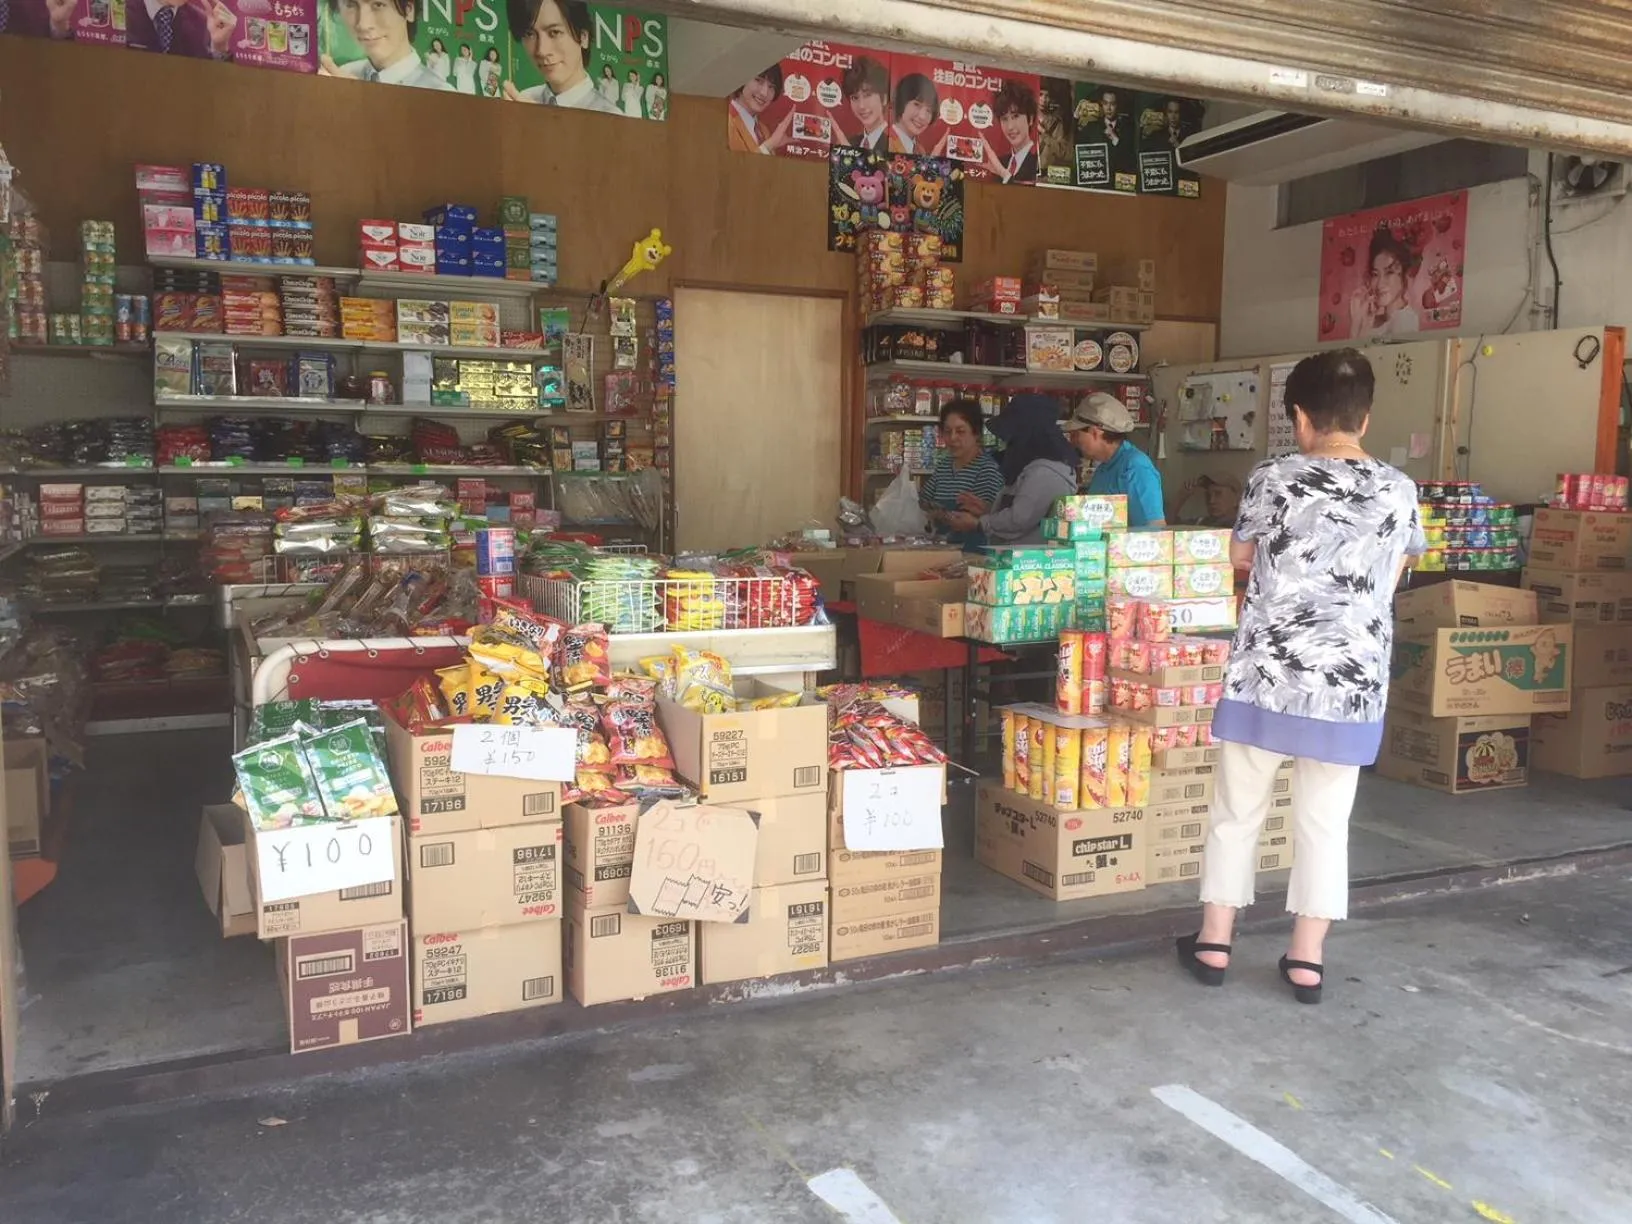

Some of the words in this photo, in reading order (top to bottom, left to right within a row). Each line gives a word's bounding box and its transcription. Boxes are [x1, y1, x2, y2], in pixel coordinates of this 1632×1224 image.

[595, 11, 664, 57] NPS
[508, 615, 545, 638] いきなり
[1446, 650, 1502, 685] うまい
[713, 730, 743, 740] 59227
[421, 740, 453, 753] Calbe
[712, 773, 746, 784] 16151
[424, 800, 462, 814] 17196
[595, 813, 627, 825] Calbee
[1112, 810, 1144, 824] 52740
[599, 824, 631, 836] 91136
[272, 834, 372, 873] ¥100
[516, 847, 552, 858] 17196
[518, 889, 553, 904] 59247
[522, 903, 556, 916] Calbee
[655, 921, 688, 935] 16903
[422, 932, 459, 946] Calbee
[426, 944, 462, 960] 59247
[791, 942, 821, 956] 59227
[655, 965, 687, 978] 91136
[659, 975, 691, 988] Calbee
[425, 988, 464, 1004] 17196
